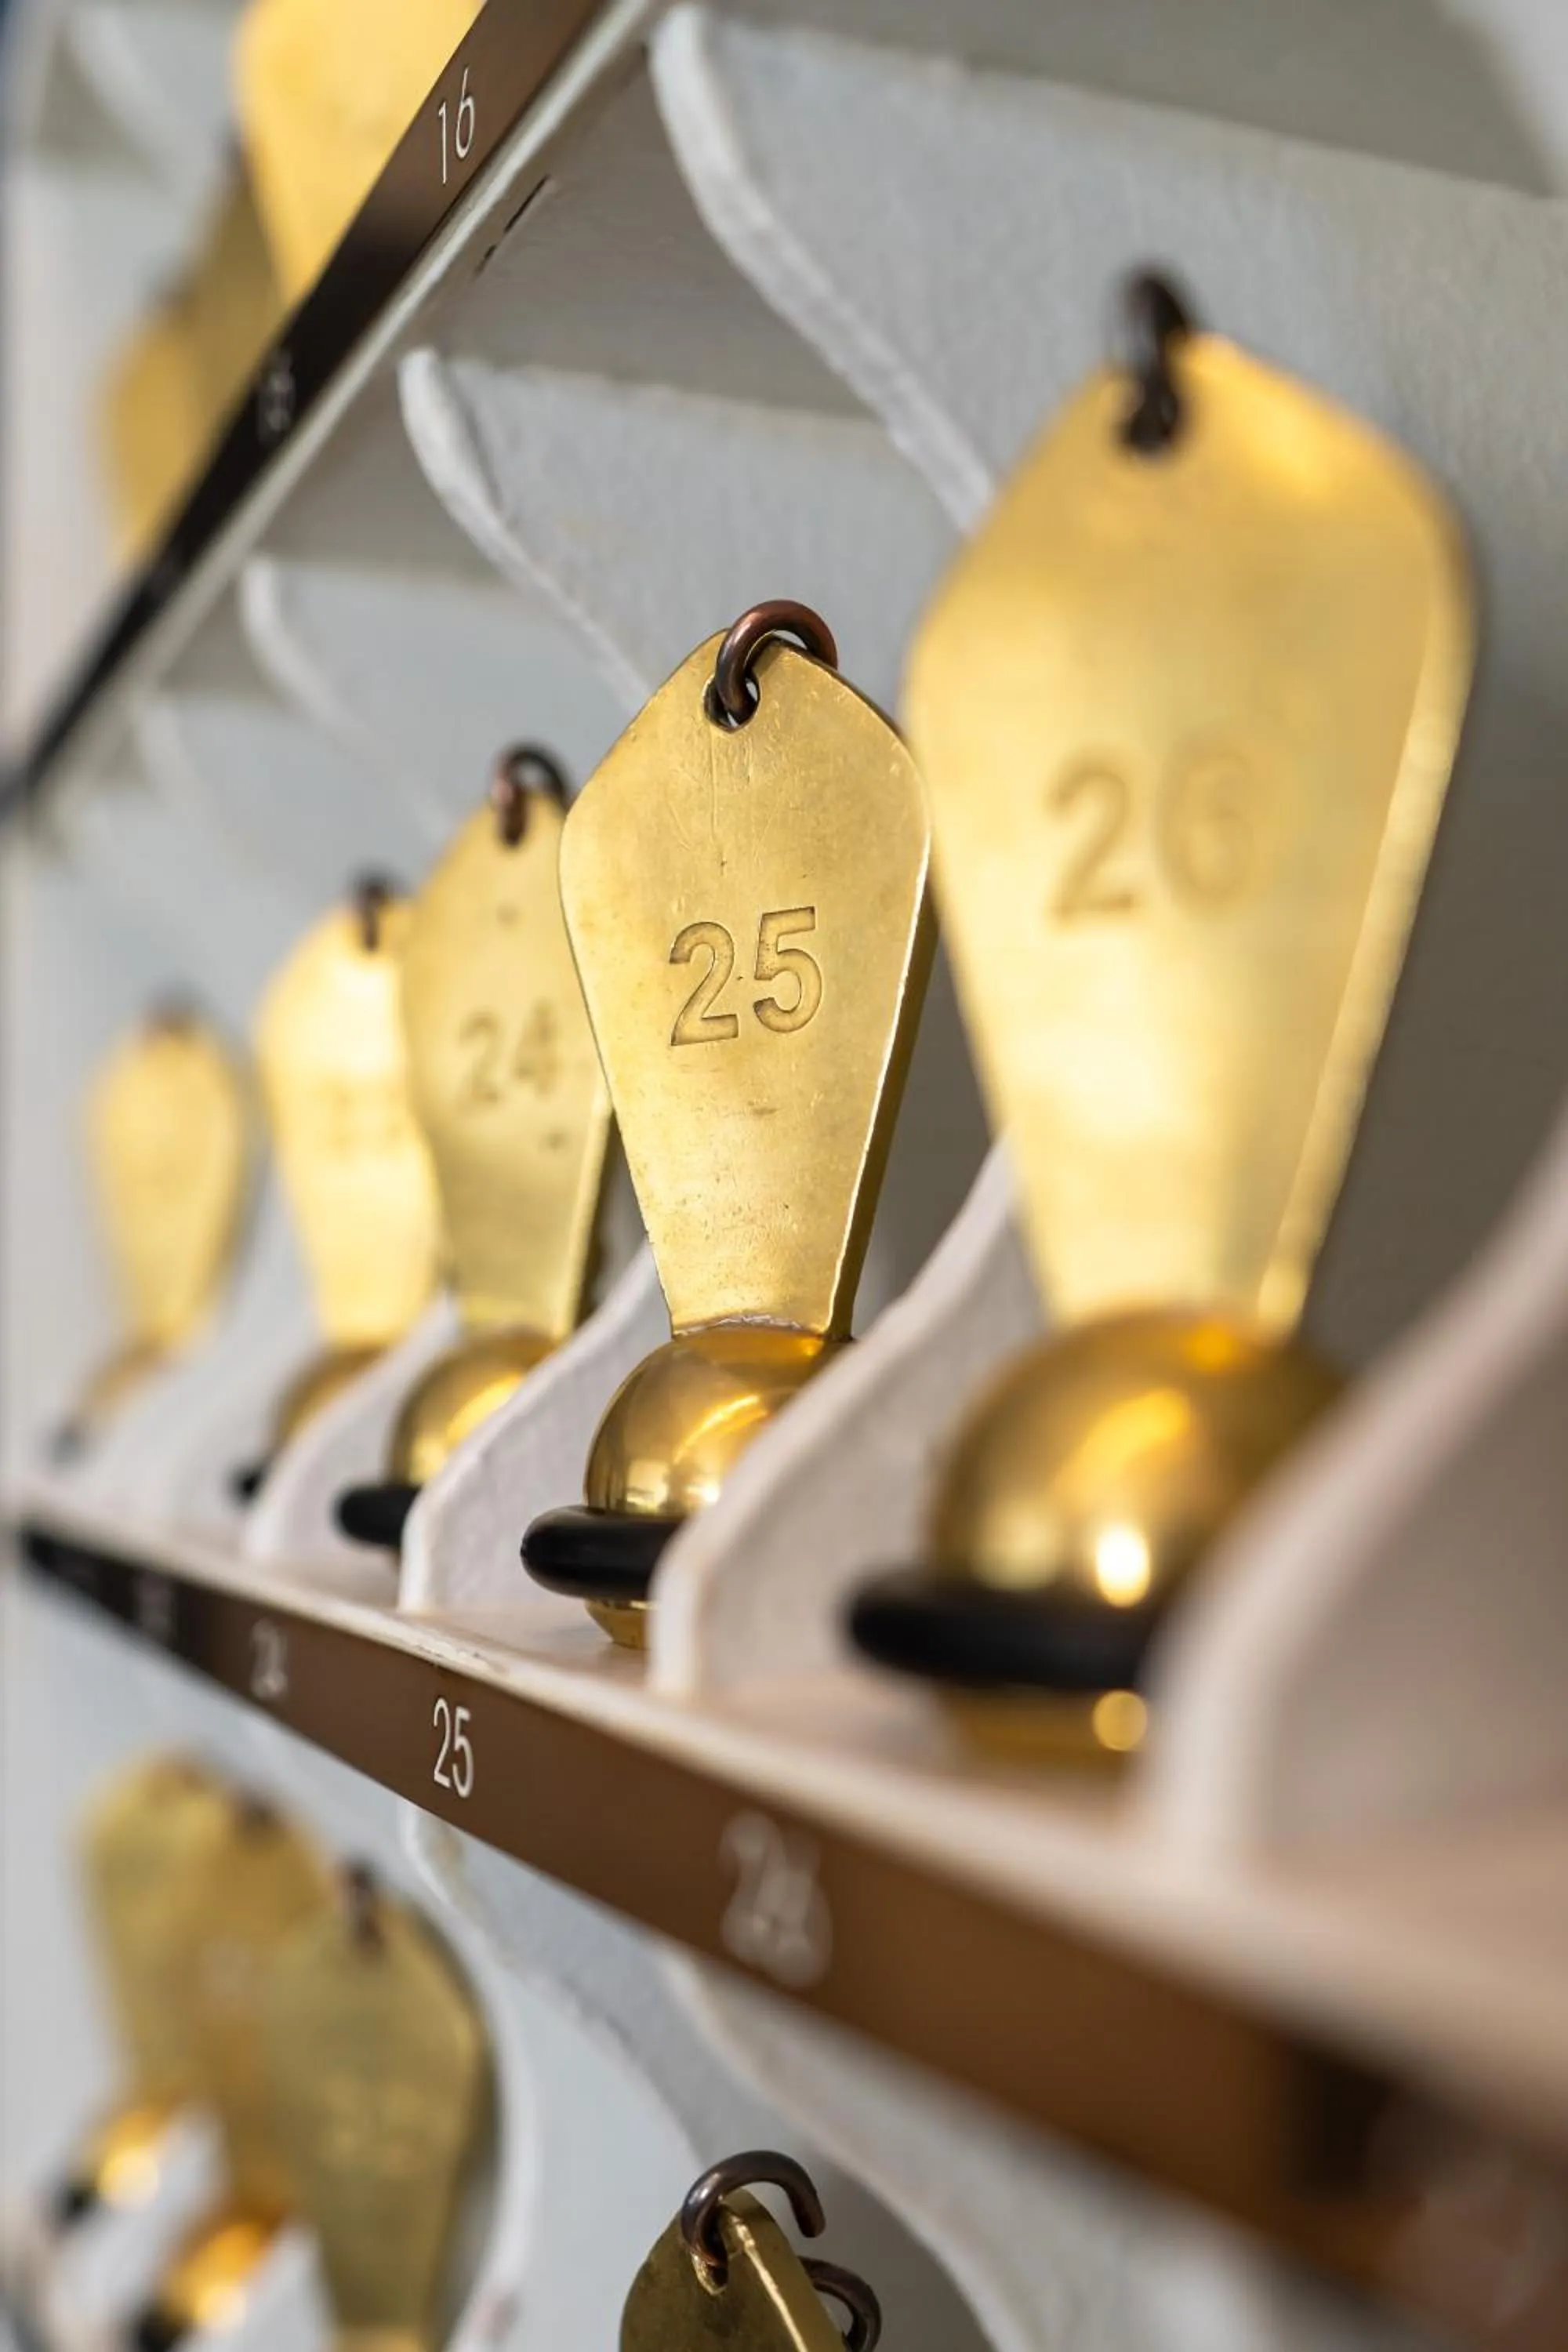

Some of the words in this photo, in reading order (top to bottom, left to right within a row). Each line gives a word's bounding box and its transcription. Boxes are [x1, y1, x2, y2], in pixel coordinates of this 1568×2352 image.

[437, 67, 475, 185] 16
[1045, 739, 1258, 925] 26
[669, 906, 823, 1047] 25
[457, 997, 563, 1113] 24
[433, 1697, 474, 1798] 25
